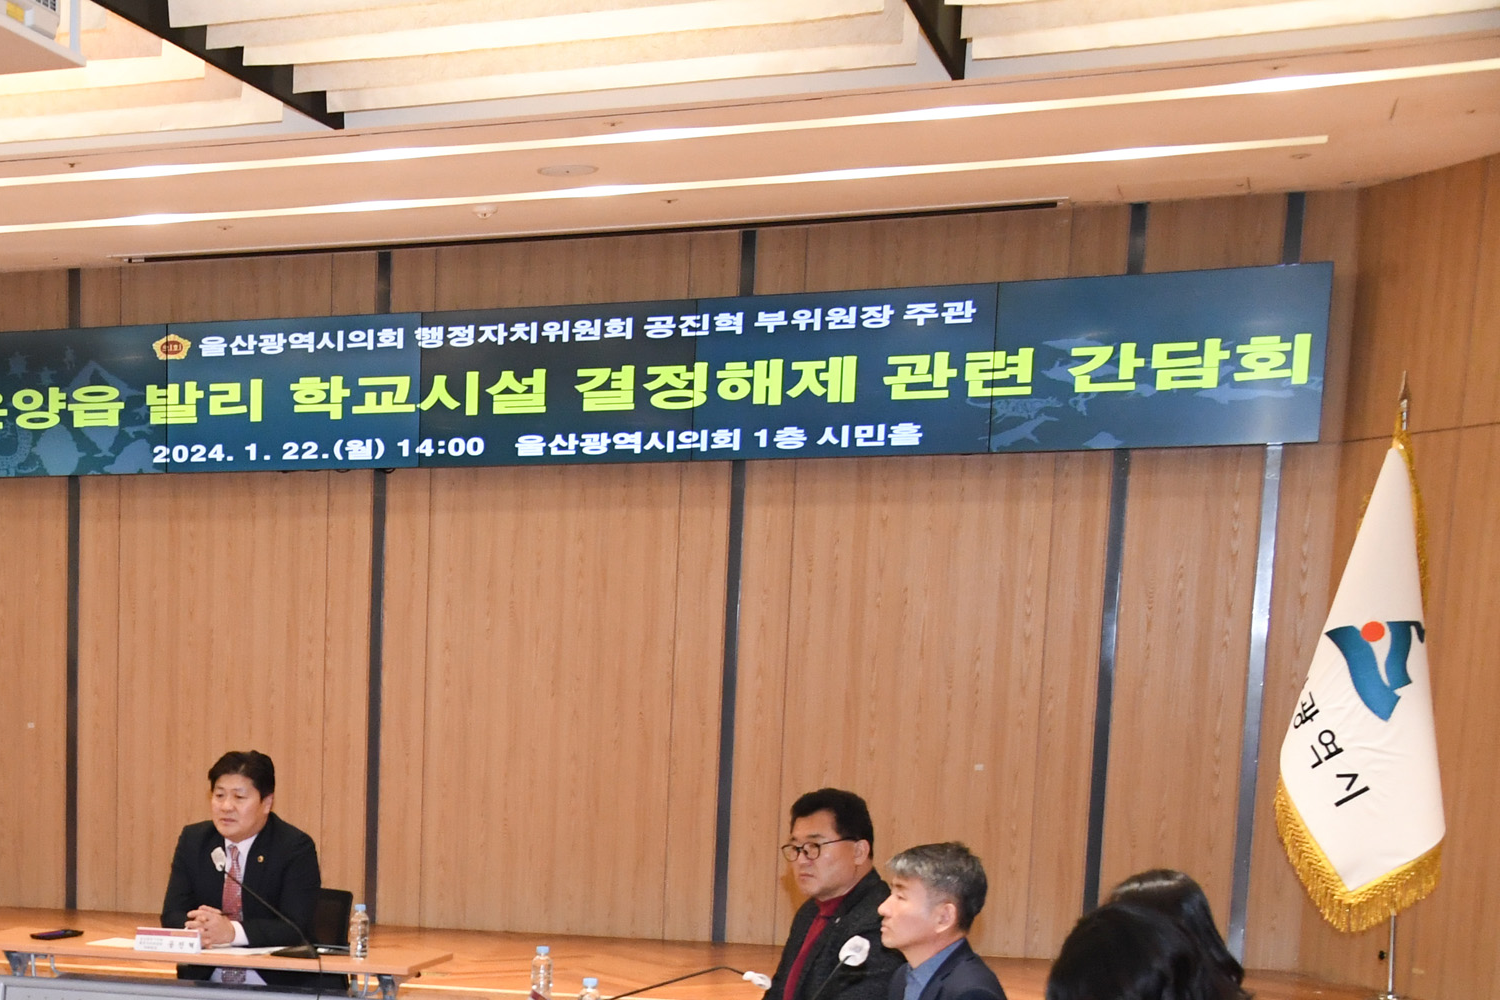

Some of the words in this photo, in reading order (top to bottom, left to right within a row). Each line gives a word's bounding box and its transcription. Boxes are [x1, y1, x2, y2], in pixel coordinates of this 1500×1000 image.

[198, 327, 404, 357] 울산광역시의회
[414, 317, 633, 349] 행정자치위원회
[643, 311, 744, 339] 공진혁
[754, 303, 895, 333] 부위원장
[903, 300, 977, 326] 주관
[145, 378, 263, 425] 발리
[289, 368, 547, 420] 학교시설
[574, 354, 858, 412] 결정해제
[882, 347, 1035, 400] 관련
[1068, 333, 1312, 393] 간담회
[152, 444, 234, 463] 2024.
[244, 443, 271, 461] 1.
[282, 438, 385, 461] 22.(월)
[397, 436, 485, 457] 14:00
[514, 428, 741, 457] 울산광역시의회
[753, 426, 807, 450] 1층
[816, 422, 923, 448] 시민홀
